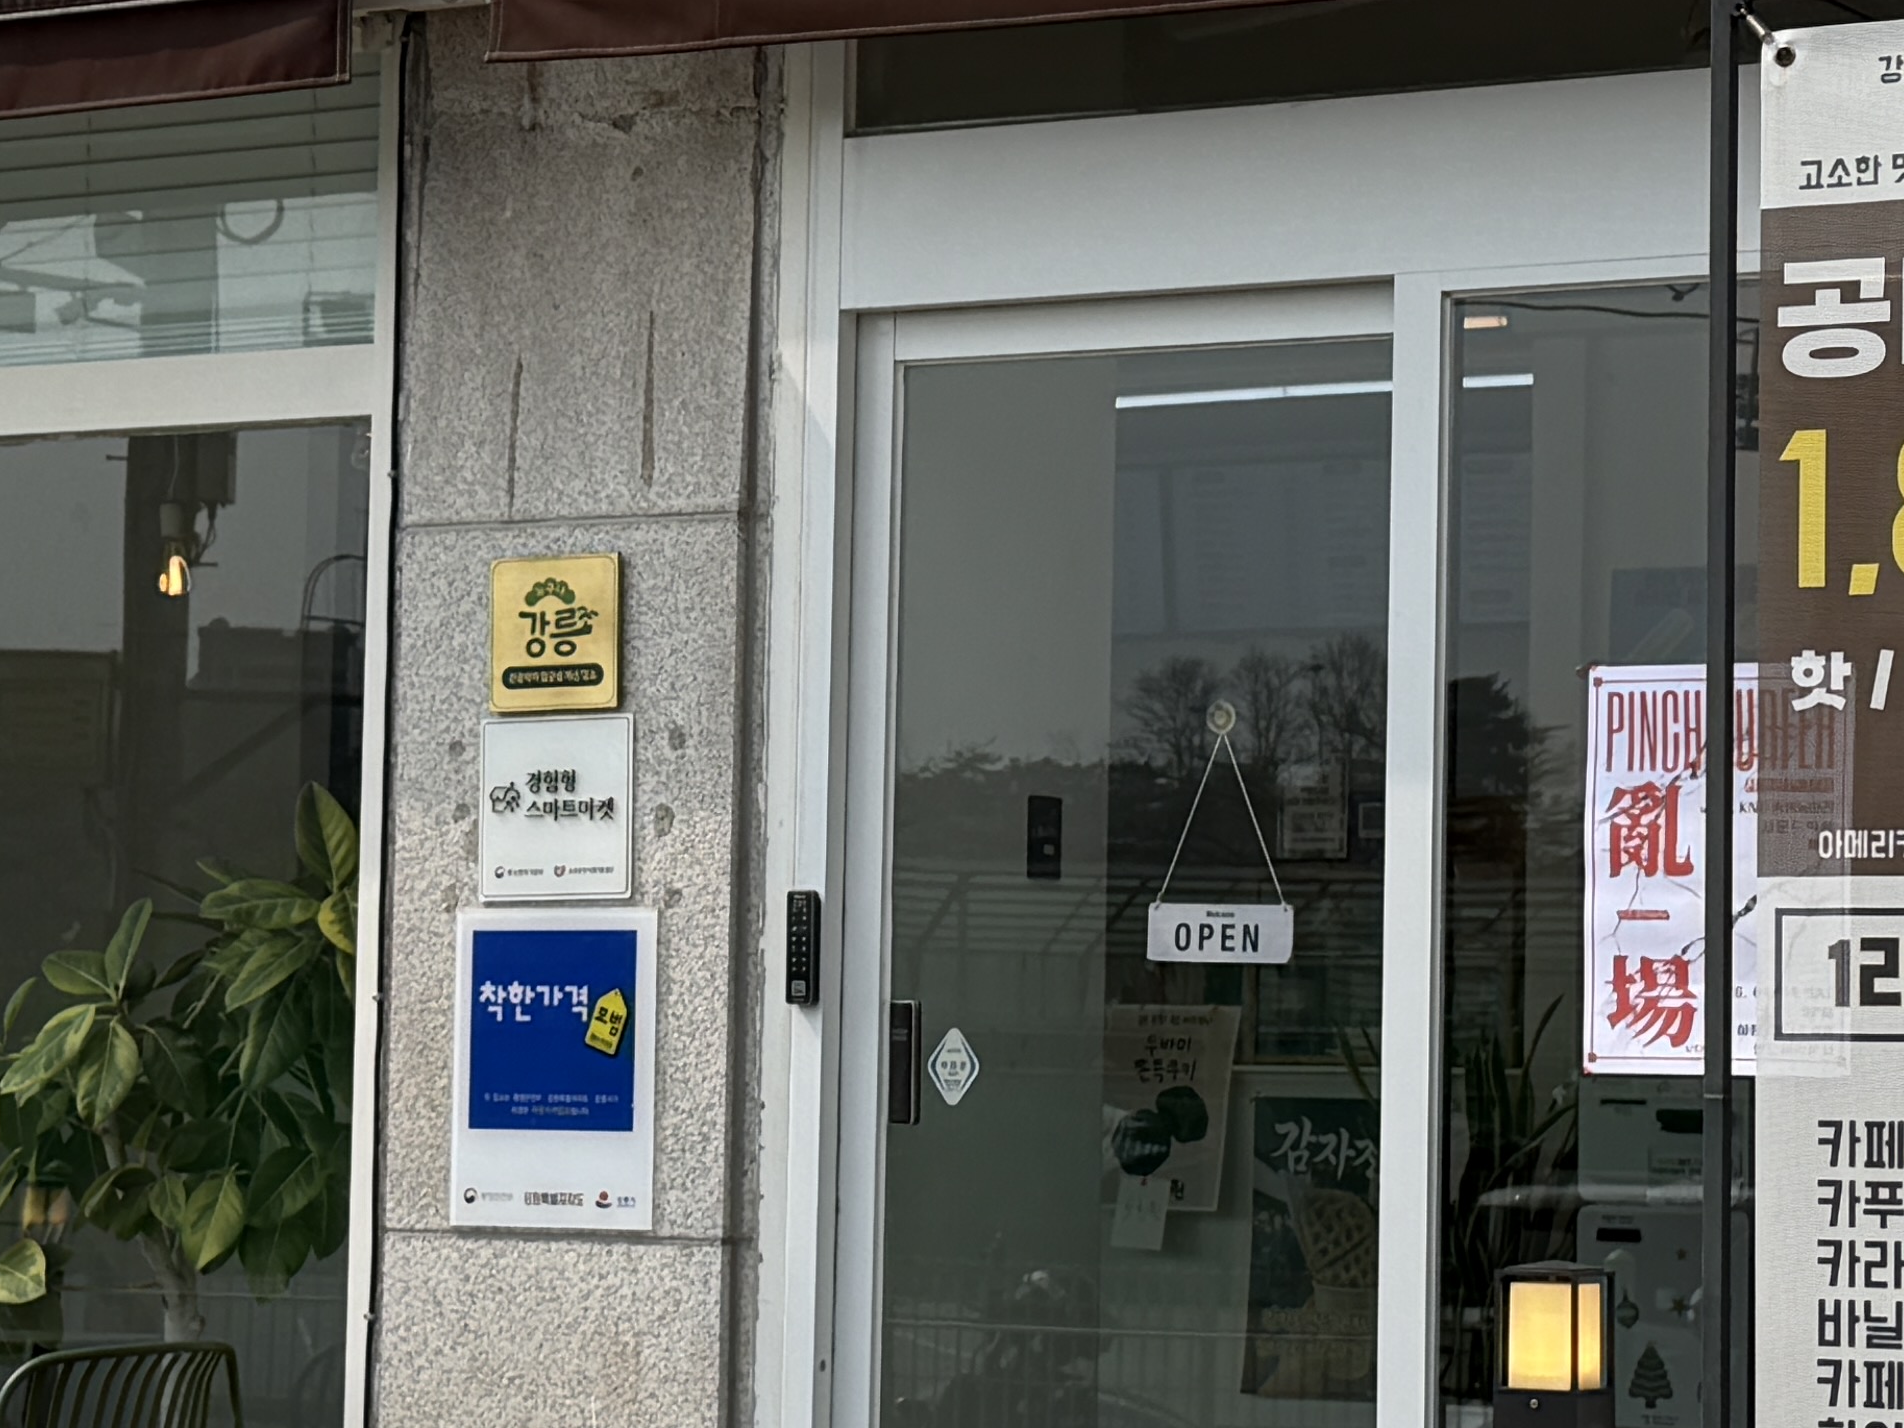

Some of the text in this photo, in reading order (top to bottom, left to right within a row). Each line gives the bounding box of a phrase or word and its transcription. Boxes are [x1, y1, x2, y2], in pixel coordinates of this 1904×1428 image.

[1798, 154, 1882, 191] 고소한
[1790, 650, 1852, 712] 핫
[1869, 649, 1895, 711] /
[1605, 688, 1702, 775] PINCH
[1174, 922, 1260, 953] OPEN
[478, 980, 589, 1022] 착한가격
